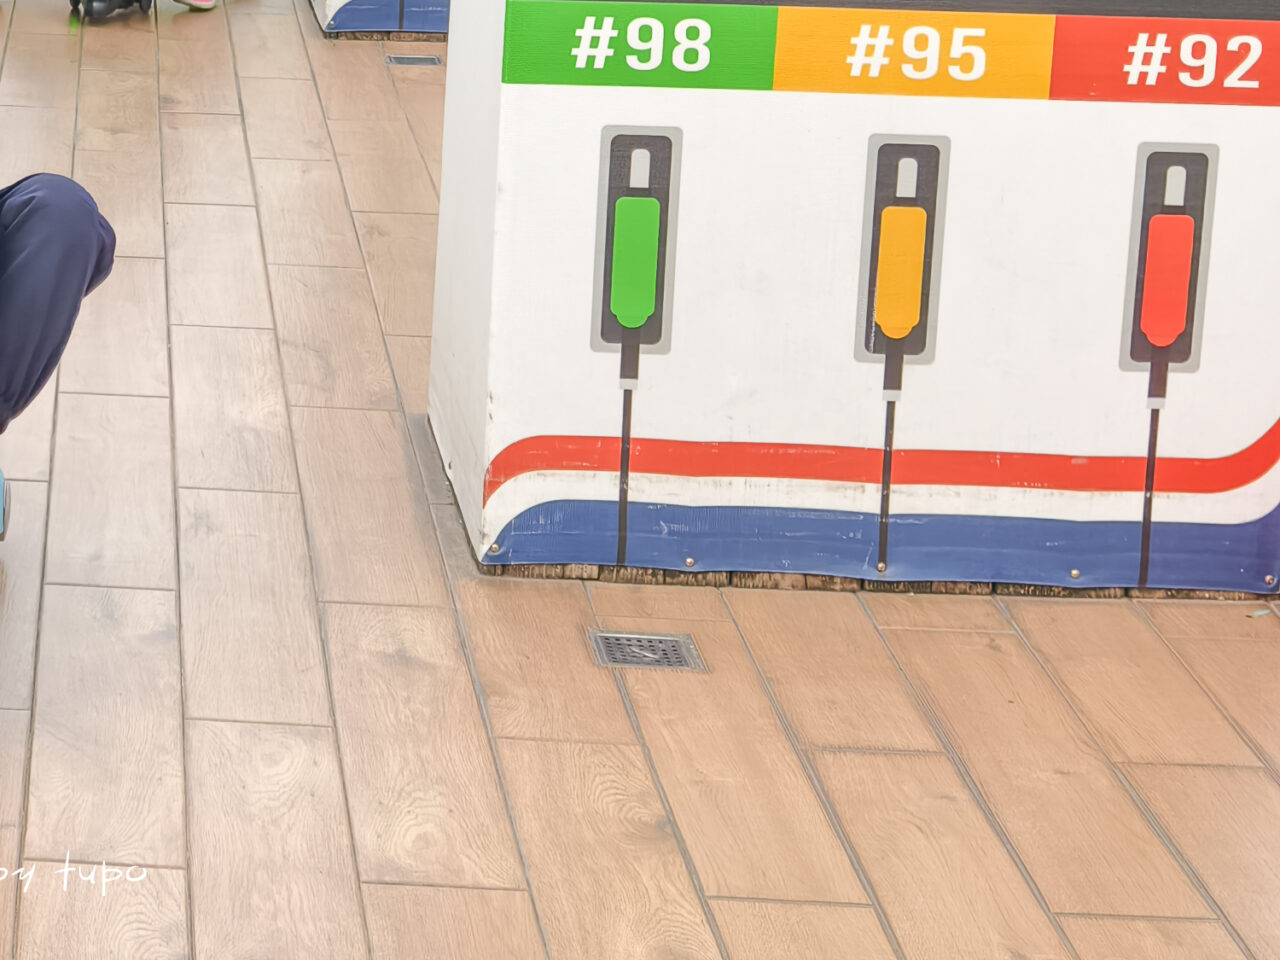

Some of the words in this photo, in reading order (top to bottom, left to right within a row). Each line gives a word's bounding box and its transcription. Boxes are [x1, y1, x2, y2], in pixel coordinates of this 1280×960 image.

[571, 15, 713, 73] #98
[845, 23, 988, 82] #95
[1122, 31, 1263, 90] #92
